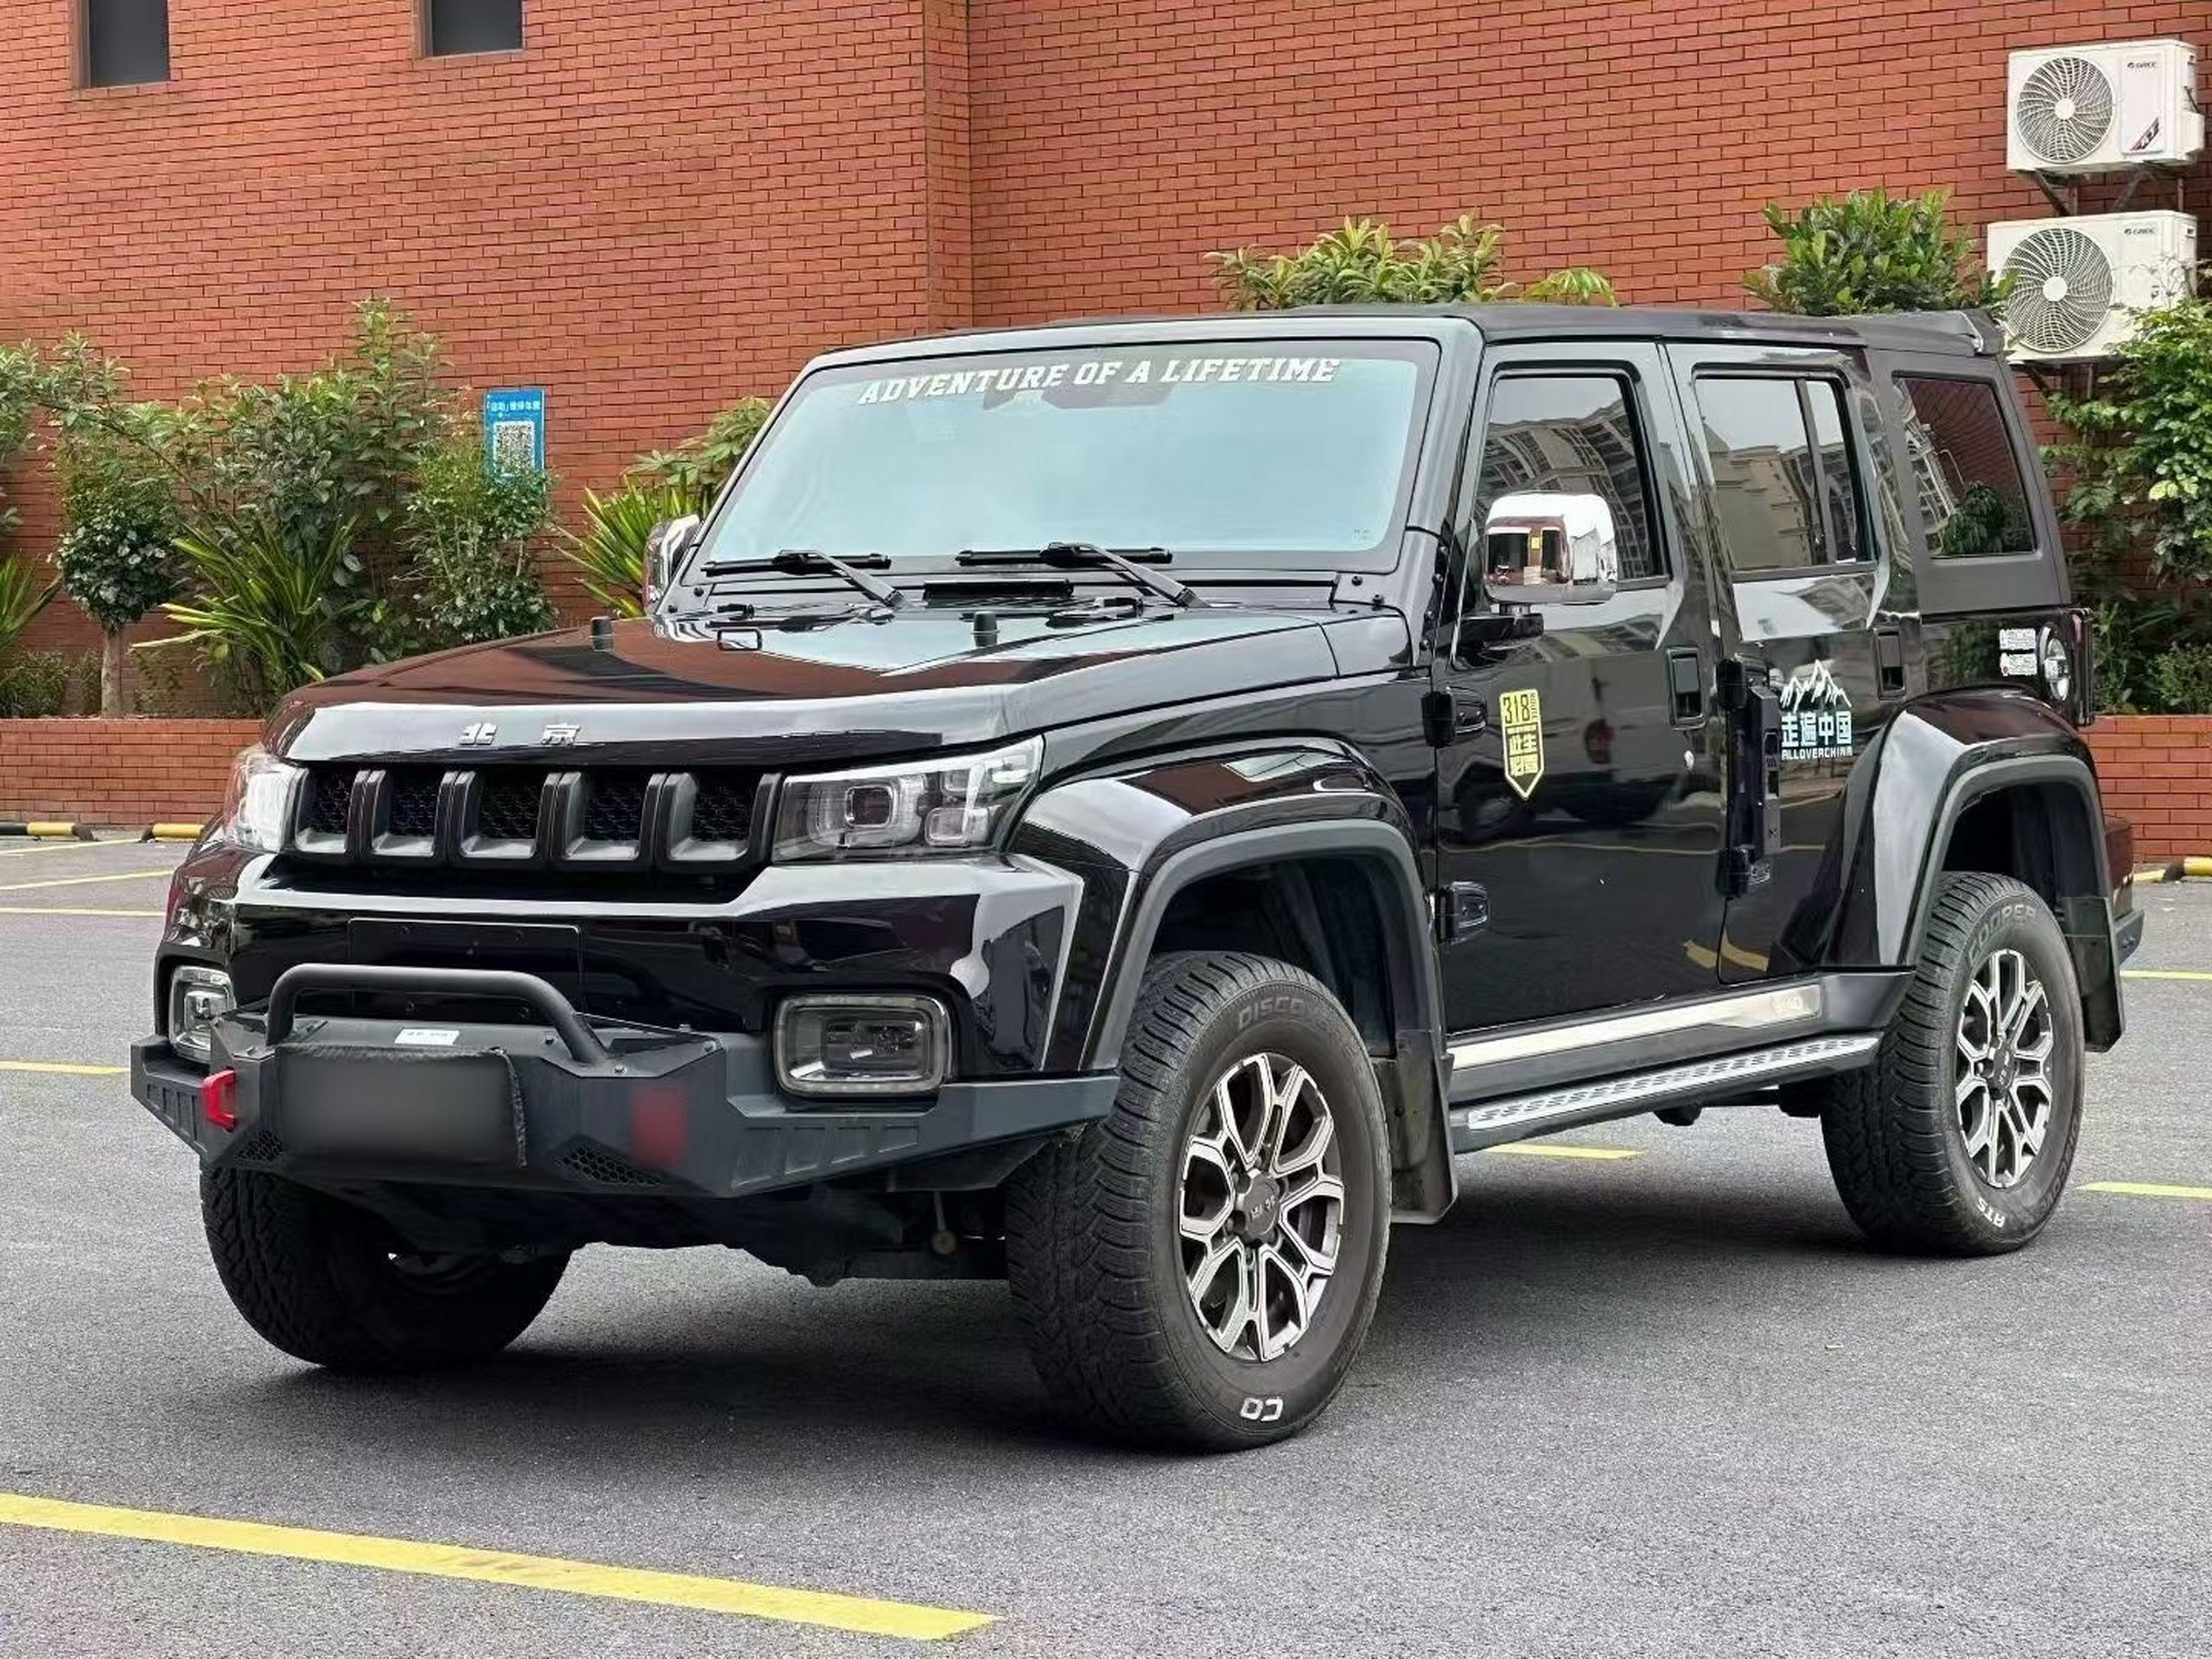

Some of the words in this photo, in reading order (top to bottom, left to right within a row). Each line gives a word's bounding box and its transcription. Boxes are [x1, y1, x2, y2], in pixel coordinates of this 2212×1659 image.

[858, 363, 1069, 405] ADVENTURE
[1074, 361, 1123, 384] OF
[1126, 360, 1153, 382] A
[1161, 358, 1341, 382] LIFETIME
[1503, 694, 1530, 724] 318
[459, 723, 580, 746] 北京
[1781, 711, 1852, 747] 走遍中国
